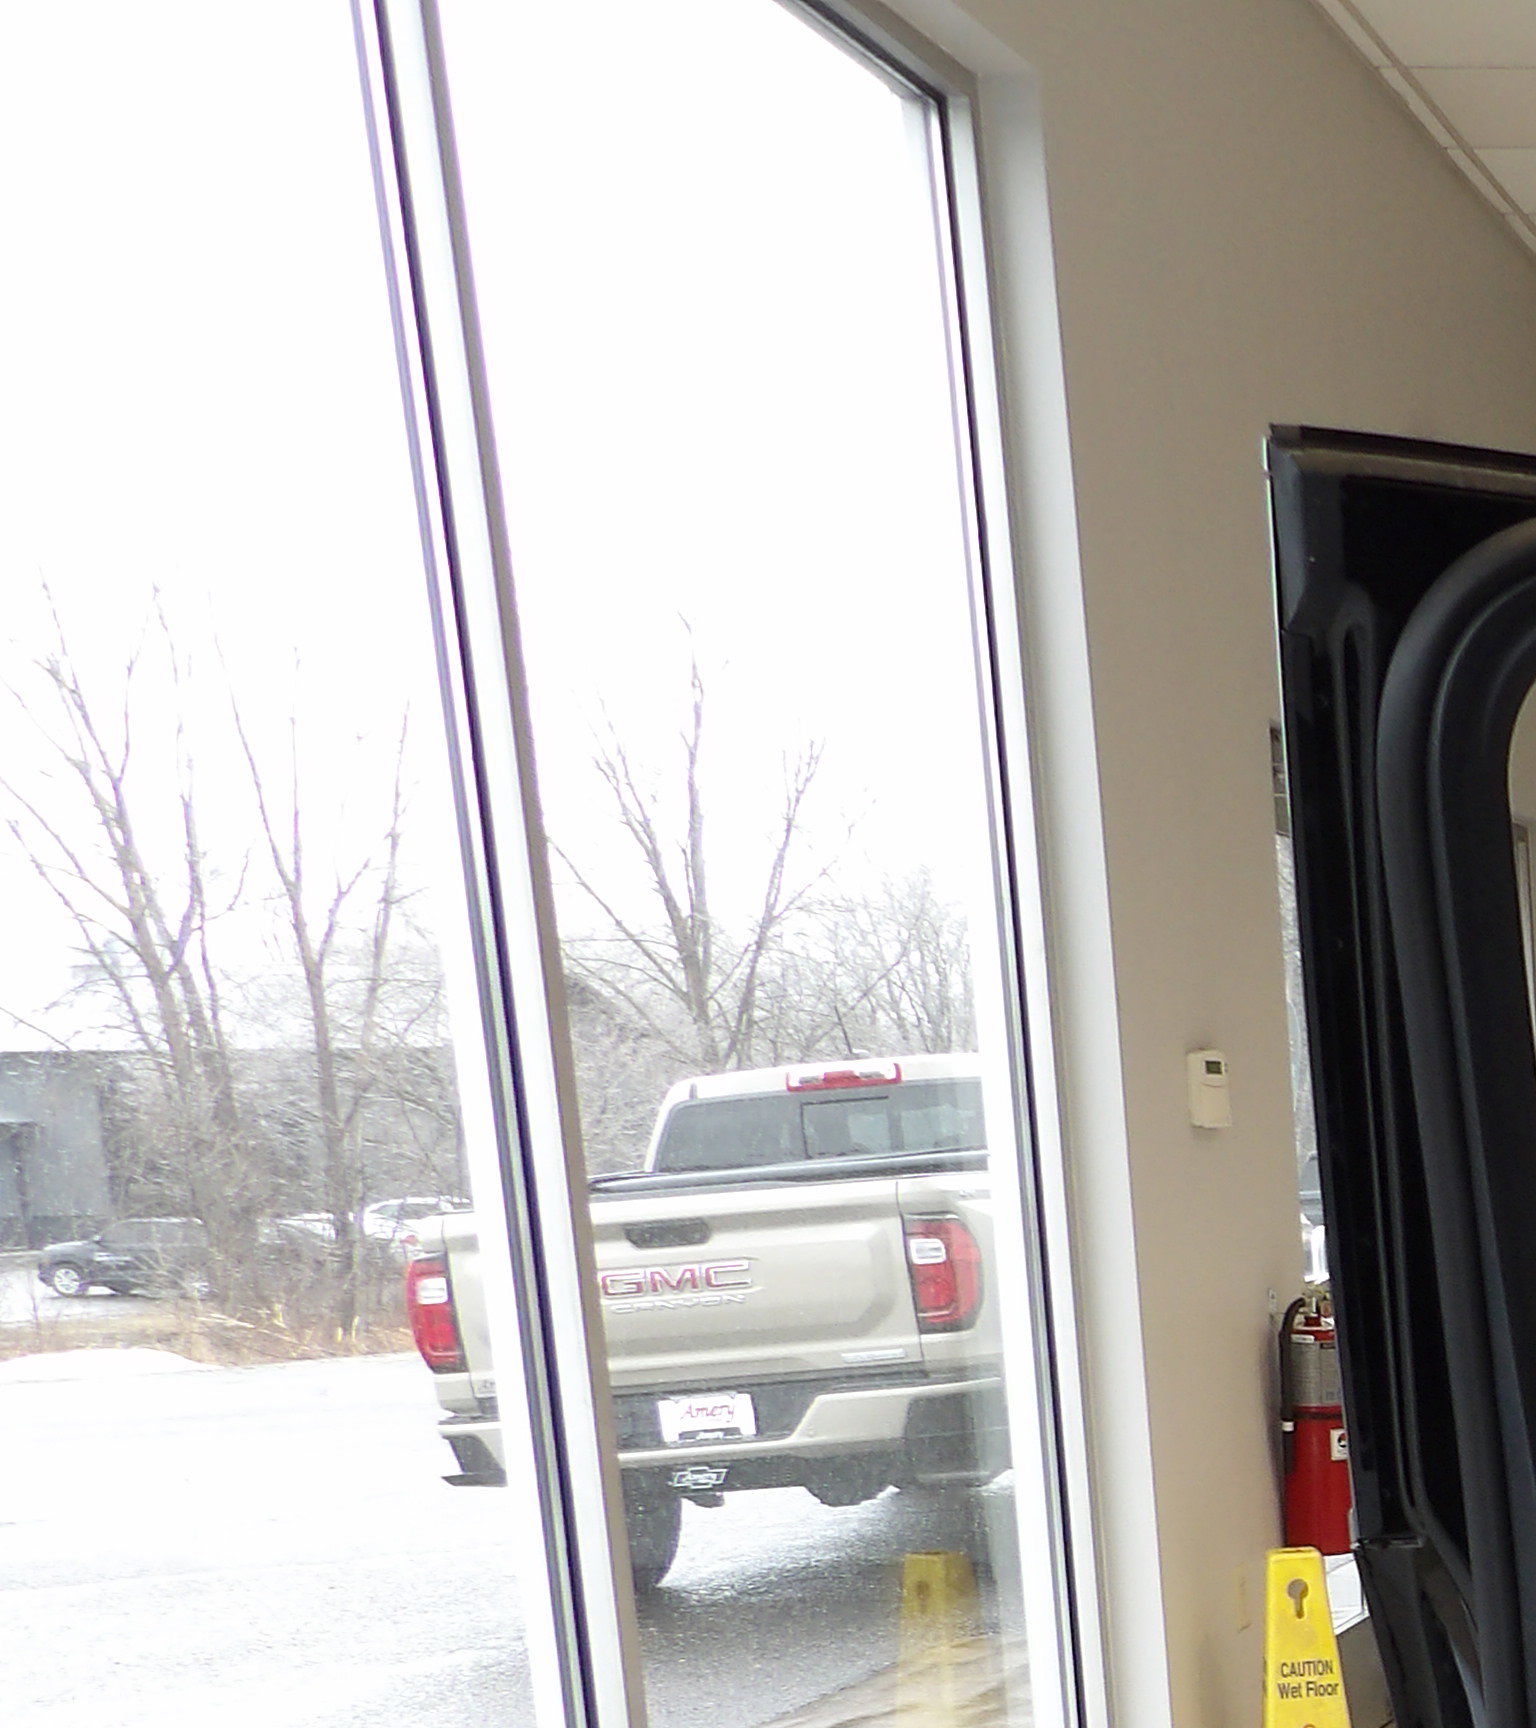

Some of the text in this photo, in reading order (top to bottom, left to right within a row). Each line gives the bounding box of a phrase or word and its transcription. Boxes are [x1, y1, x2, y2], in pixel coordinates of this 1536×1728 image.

[599, 1260, 752, 1299] GMC
[680, 1404, 735, 1424] Amery
[1280, 1659, 1334, 1678] CAUTION
[1276, 1680, 1340, 1699] Wet Floor
